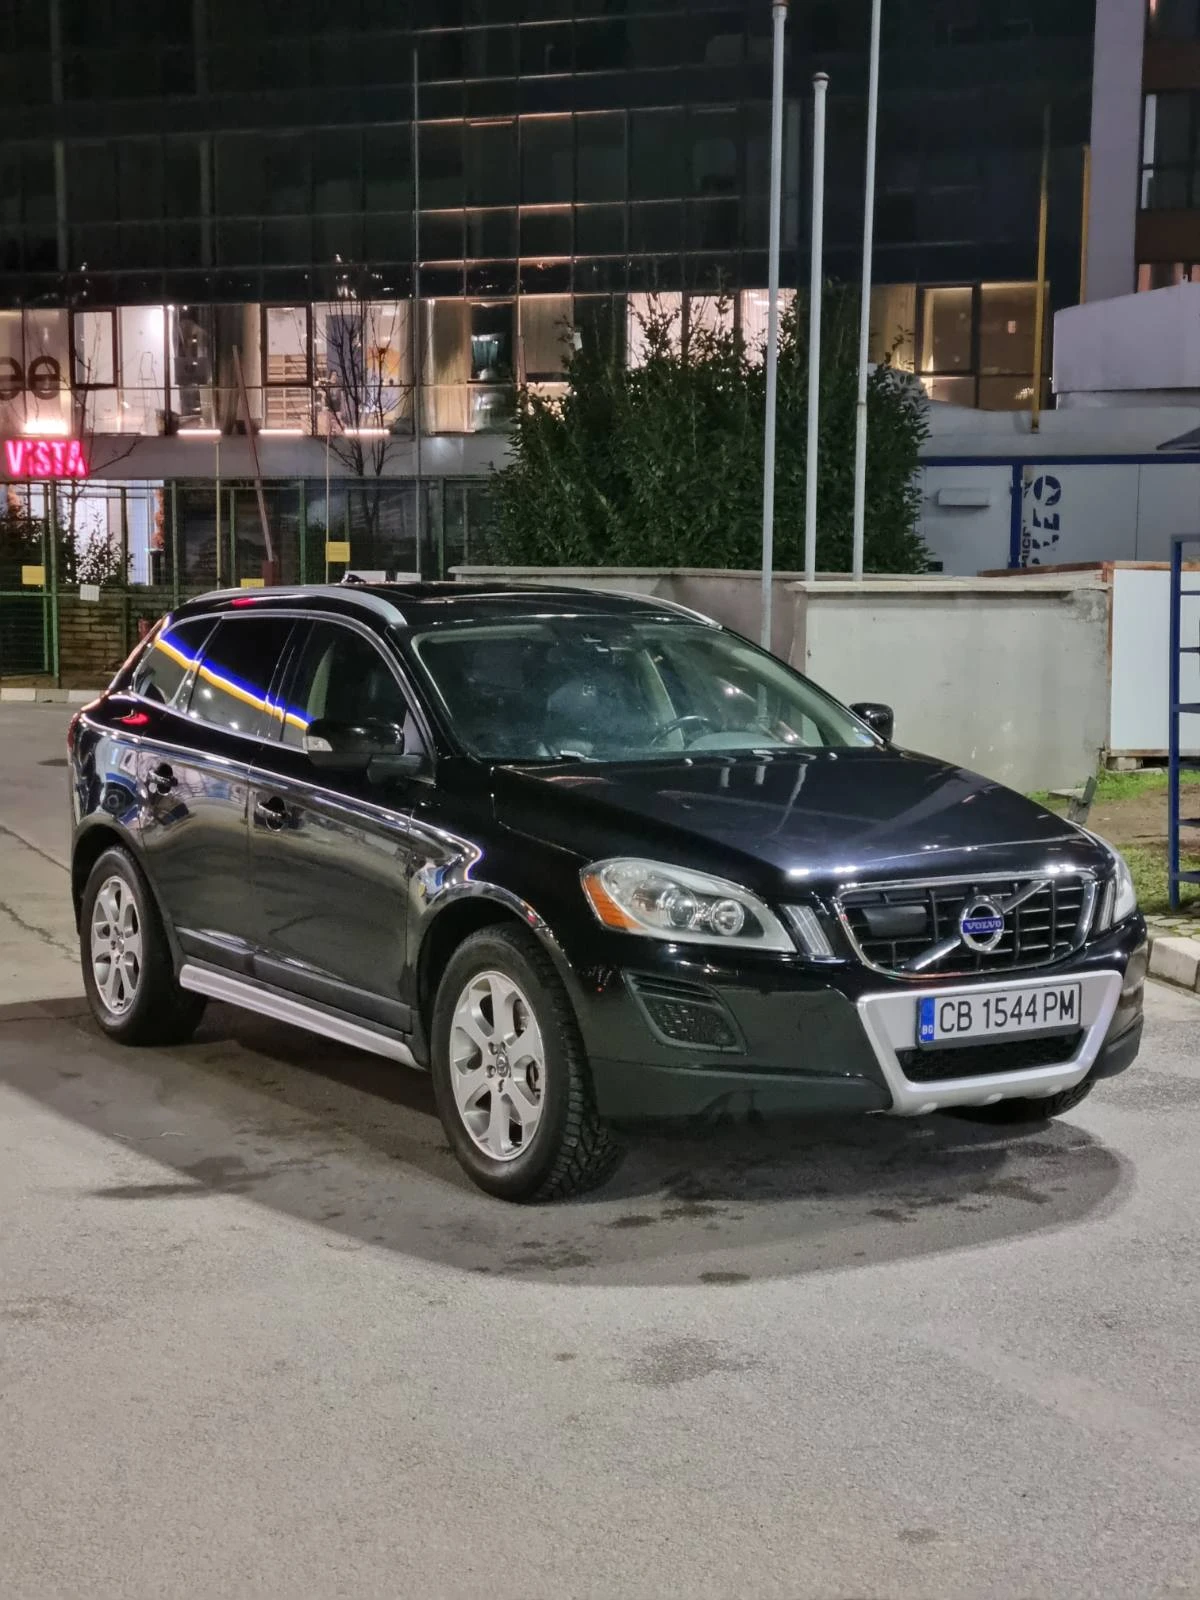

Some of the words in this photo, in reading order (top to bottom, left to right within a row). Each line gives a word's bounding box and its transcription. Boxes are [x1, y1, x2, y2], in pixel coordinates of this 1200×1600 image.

[965, 919, 1002, 930] VOLVO
[940, 1000, 973, 1033] CB
[982, 993, 1038, 1029] 1544
[1043, 989, 1075, 1022] PM
[922, 1024, 933, 1035] BG
